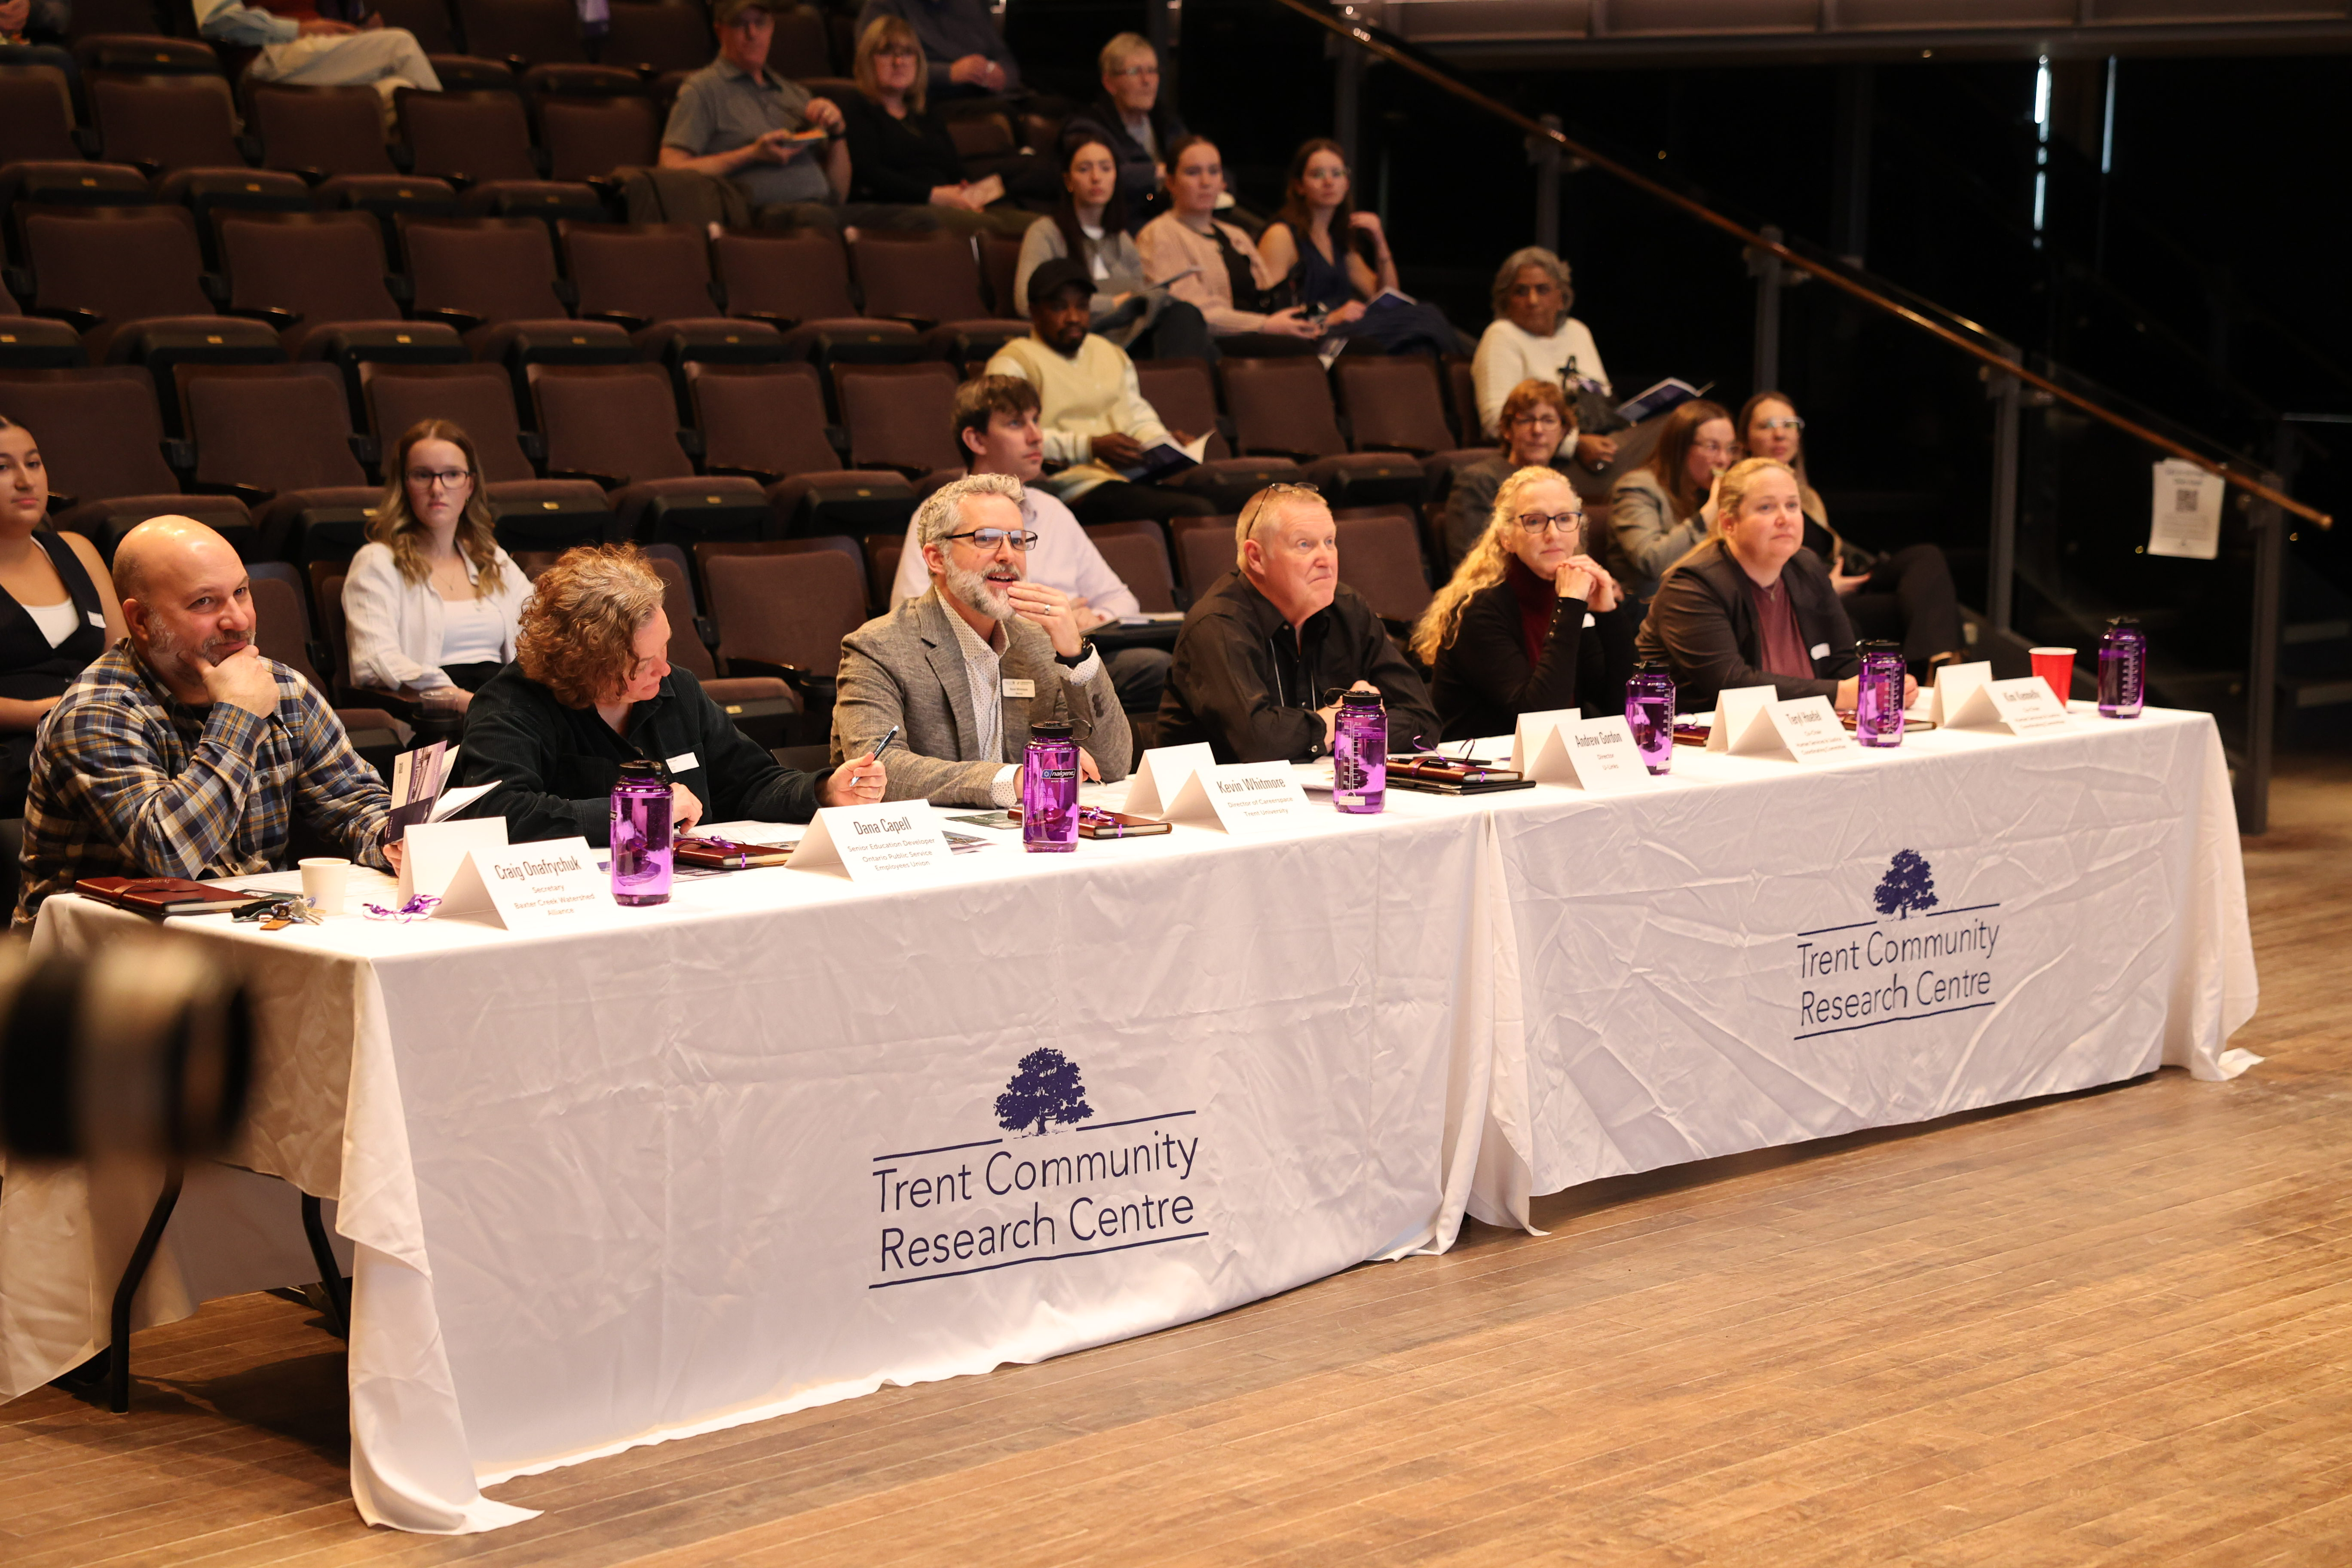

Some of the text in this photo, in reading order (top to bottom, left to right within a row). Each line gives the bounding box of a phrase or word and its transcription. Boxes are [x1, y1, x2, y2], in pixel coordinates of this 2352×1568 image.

[1575, 731, 1622, 747] Andrew Gordon
[1216, 777, 1286, 793] Kevin Whitmore
[1259, 797, 1293, 805] Careerspace
[1261, 808, 1288, 816] University
[853, 817, 912, 835] Dana Capell
[869, 842, 902, 850] Education
[902, 838, 935, 846] Developer
[494, 855, 581, 880] Craig Onafrychuk
[875, 862, 910, 871] Employees
[532, 885, 564, 893] Secretary
[558, 893, 595, 903] Watershed
[1797, 918, 2000, 978] Trent Community
[1801, 970, 1991, 1026] Research Centre
[873, 1130, 1198, 1213] Trent Community
[881, 1194, 1194, 1272] Research Centre
